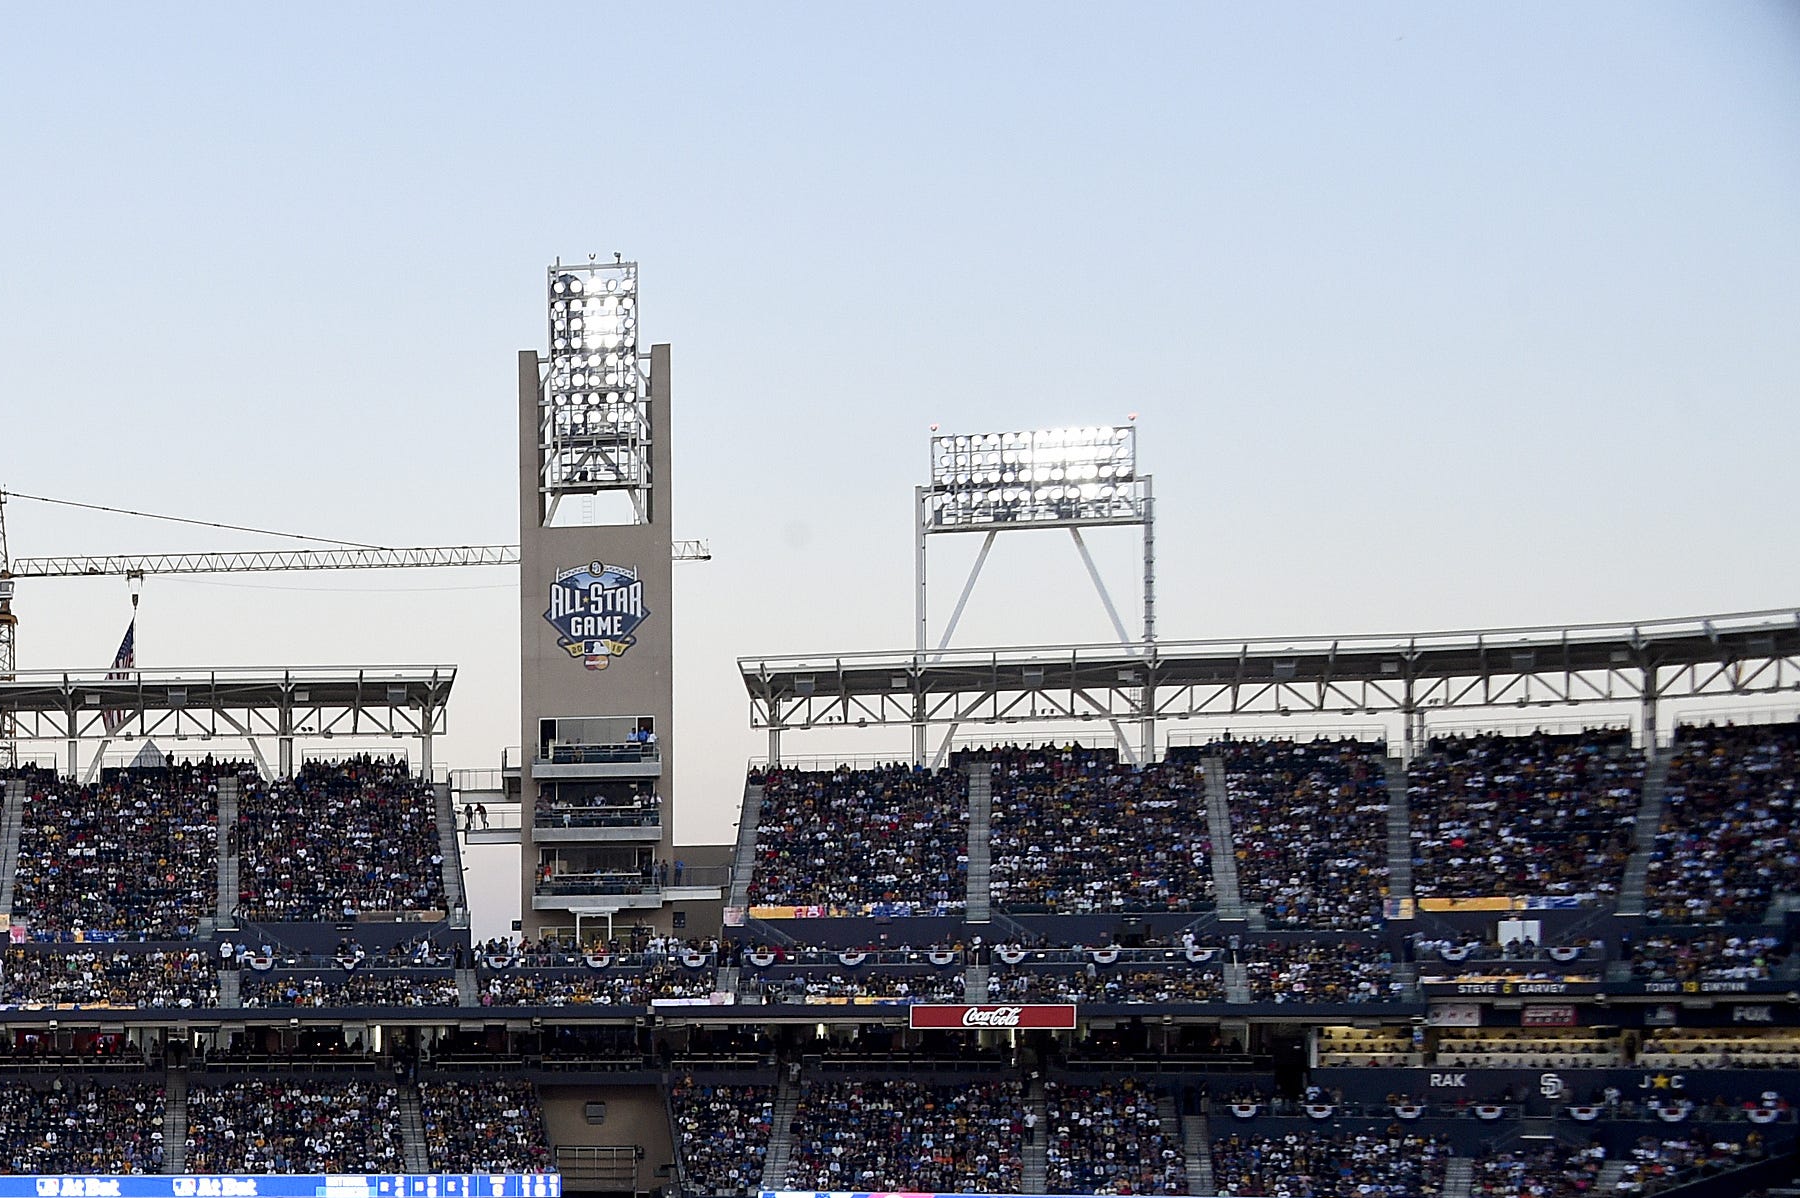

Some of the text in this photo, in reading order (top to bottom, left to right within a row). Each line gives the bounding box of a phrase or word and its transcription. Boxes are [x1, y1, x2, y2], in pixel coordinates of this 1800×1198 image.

[571, 616, 622, 636] GAME
[1458, 984, 1567, 994] STEVE 6 GARVEY
[1645, 983, 1676, 991] TONY
[1701, 982, 1748, 991] GWYNN
[1733, 1006, 1771, 1020] FOX
[1430, 1073, 1467, 1087] RAK
